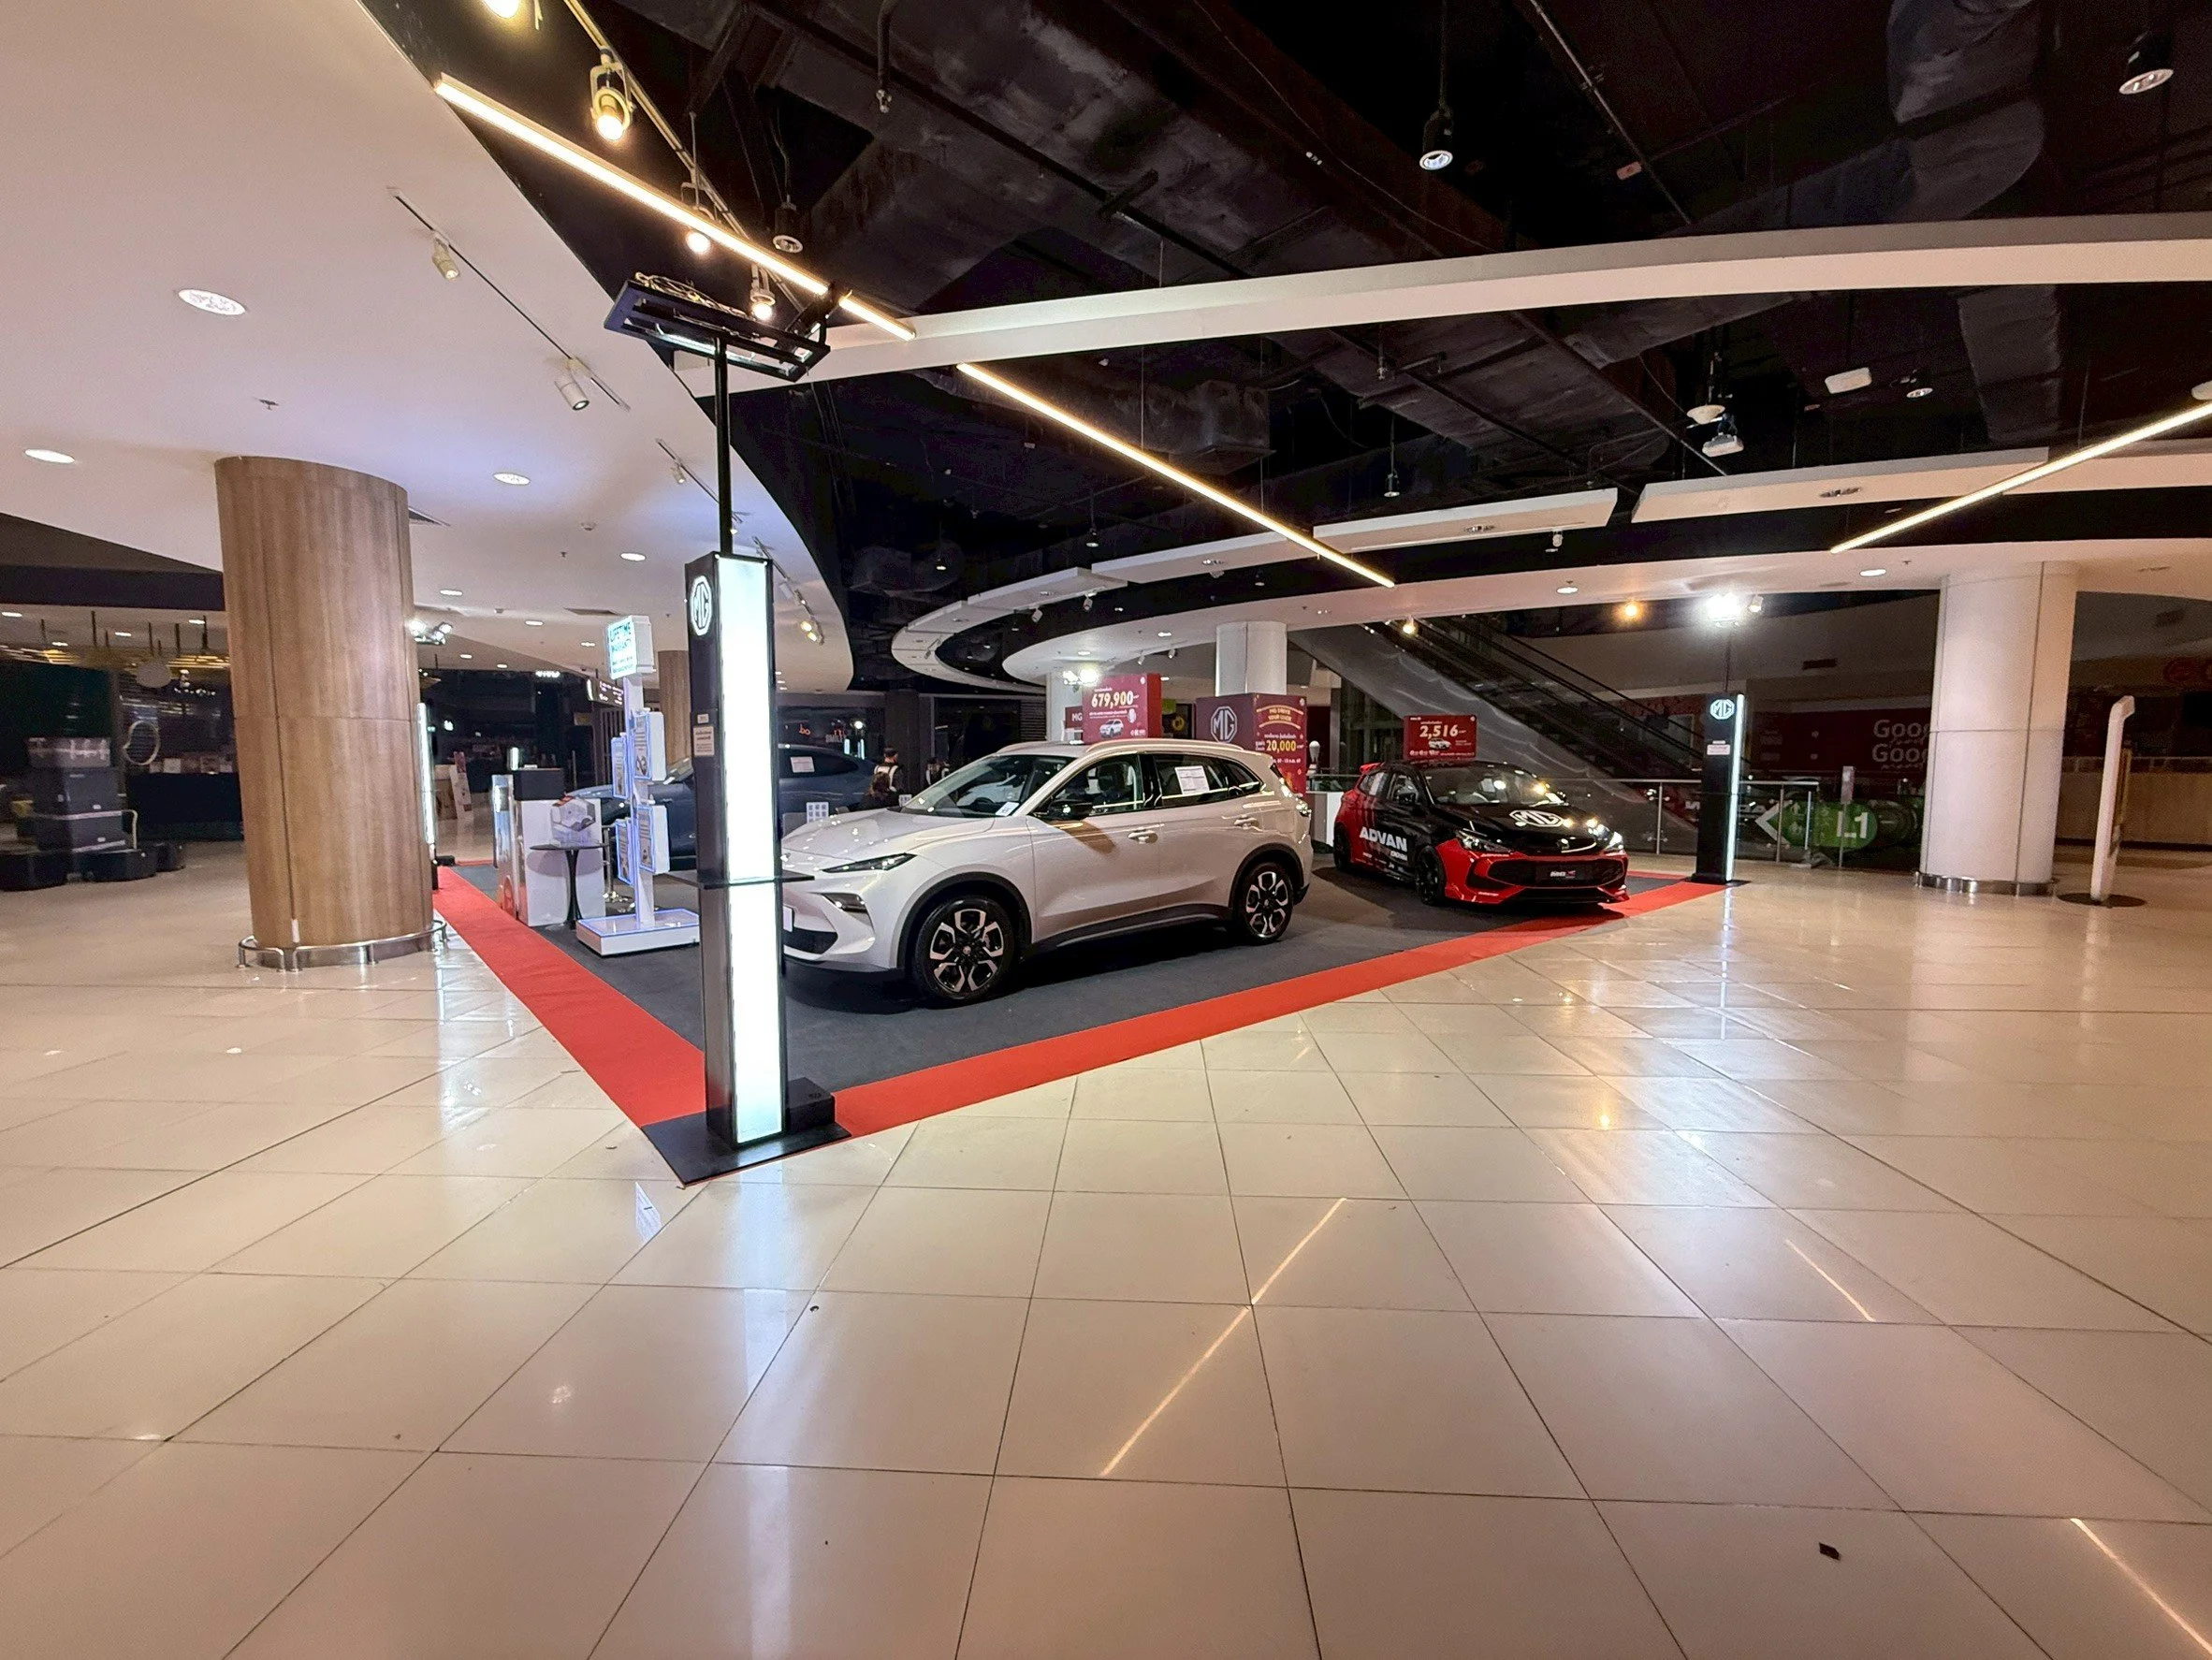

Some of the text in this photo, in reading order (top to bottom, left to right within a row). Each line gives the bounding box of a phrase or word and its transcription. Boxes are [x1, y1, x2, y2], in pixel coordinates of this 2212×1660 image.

[692, 580, 710, 631] MG
[1091, 691, 1134, 709] 679,900
[1710, 700, 1734, 720] MG
[1213, 707, 1236, 741] MG
[1419, 724, 1459, 739] 2,516
[1266, 740, 1296, 753] 20,000
[1510, 810, 1562, 826] MG
[1836, 811, 1870, 839] L1
[1359, 826, 1408, 852] ADVAN
